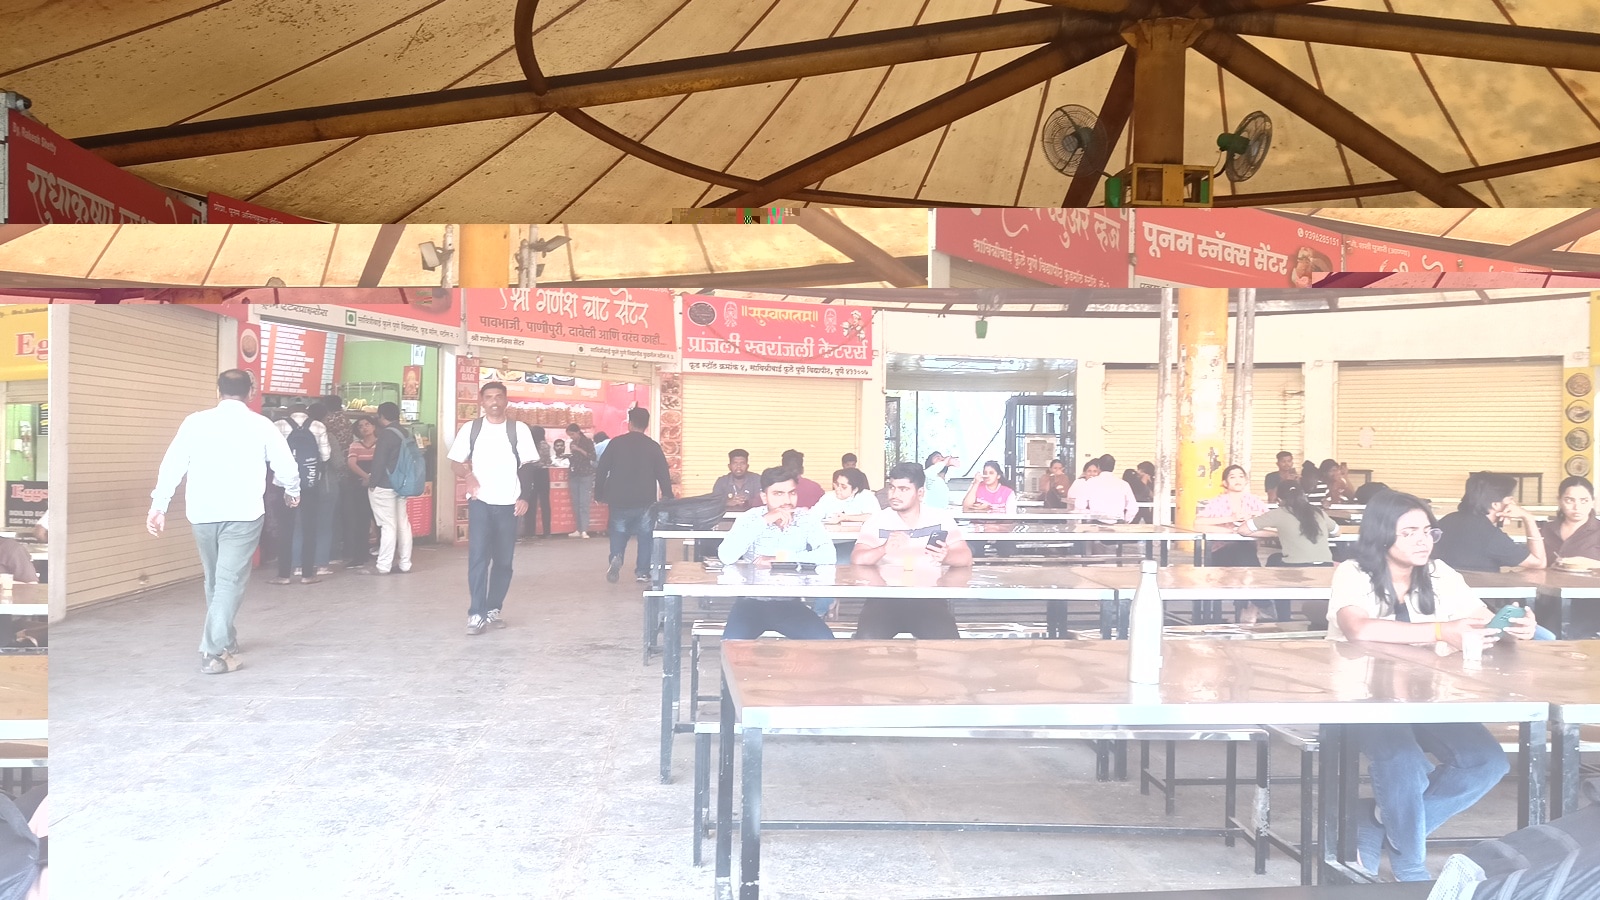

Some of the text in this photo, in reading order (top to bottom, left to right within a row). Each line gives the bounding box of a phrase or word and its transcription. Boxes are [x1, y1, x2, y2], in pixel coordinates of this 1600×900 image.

[1142, 221, 1288, 276] पूनम स्नॅक्स सेंटर
[581, 295, 611, 322] चाट
[479, 316, 523, 333] पावभाजी,
[526, 320, 566, 339] पाणीपुरी,
[567, 324, 597, 339] दावेली
[598, 327, 620, 341] आणि
[687, 330, 869, 360] प्रांजली स्वरांजली केटरर्स
[459, 365, 479, 375] JUICE
[461, 373, 476, 382] BAR
